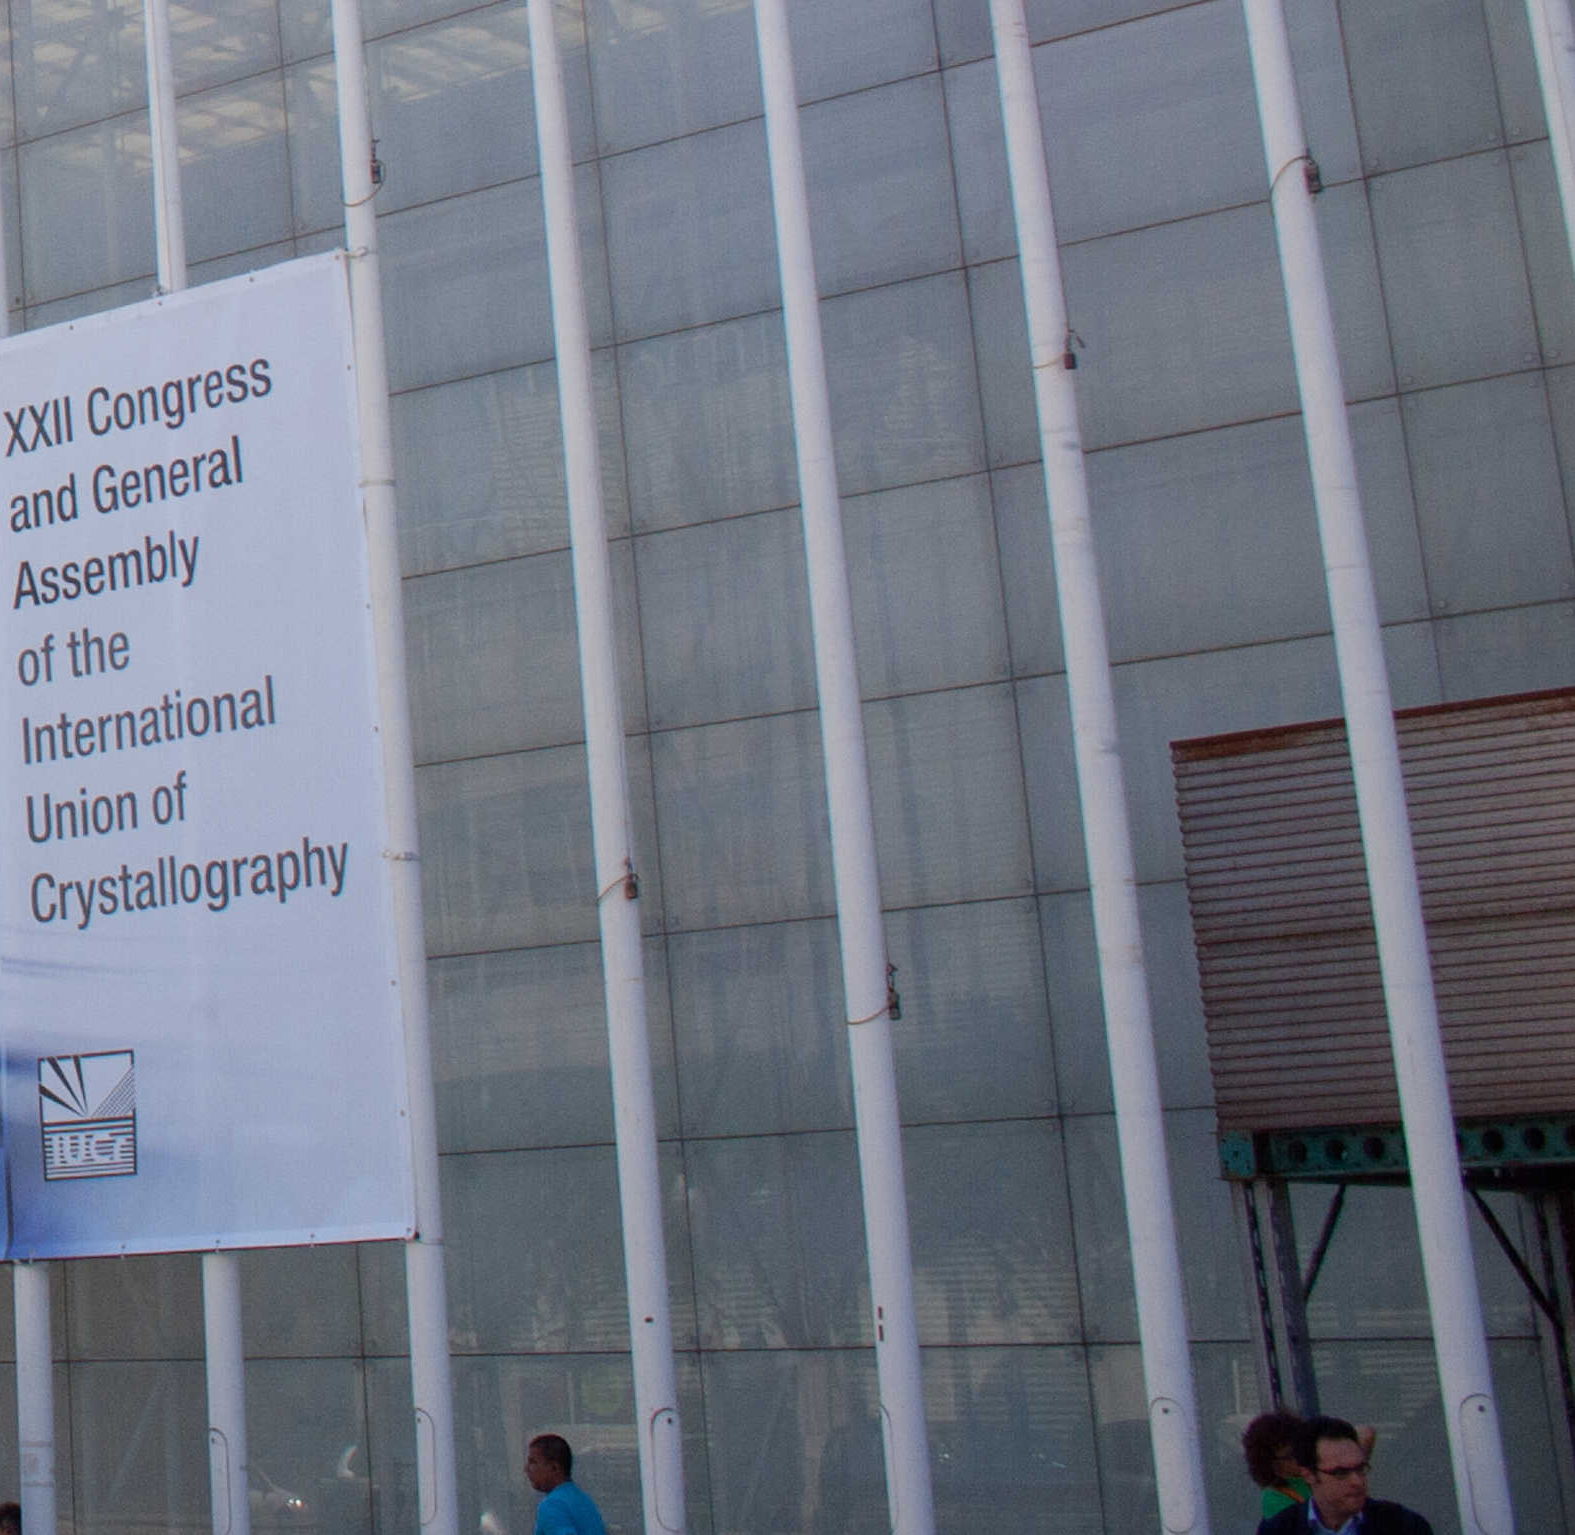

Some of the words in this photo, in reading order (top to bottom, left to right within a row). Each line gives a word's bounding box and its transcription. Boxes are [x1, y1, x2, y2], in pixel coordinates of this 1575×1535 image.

[3, 395, 74, 458] XXII
[86, 358, 272, 437] Congress
[10, 472, 79, 533] and
[92, 434, 243, 514] General
[13, 530, 200, 610] Assembly
[18, 633, 55, 687] of
[66, 627, 130, 679] the
[22, 675, 276, 764] International
[26, 787, 139, 843] Union
[151, 770, 187, 825] of
[30, 836, 348, 930] Crystallography
